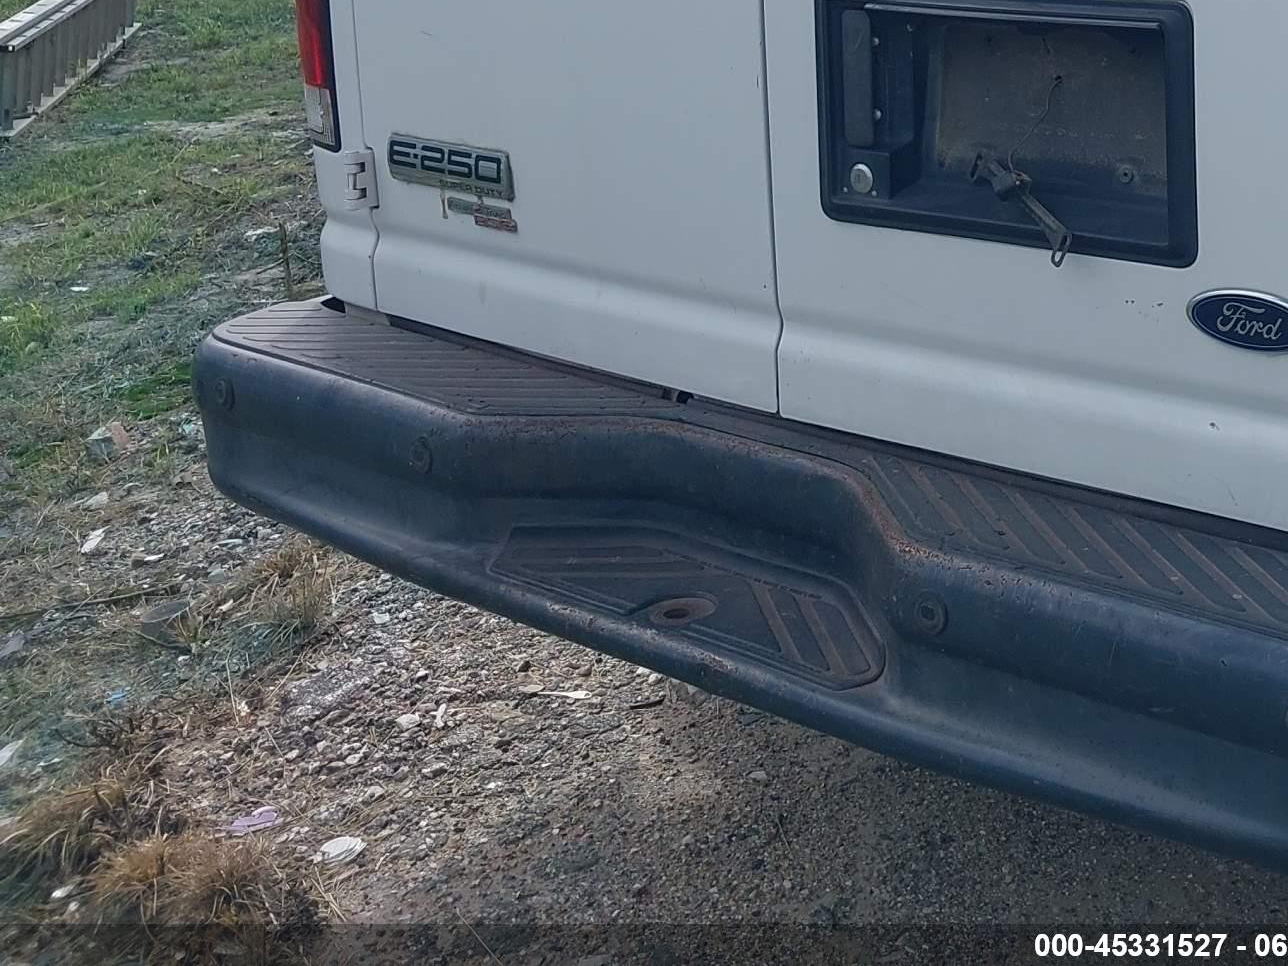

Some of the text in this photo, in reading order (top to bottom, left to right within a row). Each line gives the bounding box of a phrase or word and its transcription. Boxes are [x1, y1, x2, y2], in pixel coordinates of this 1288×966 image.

[389, 140, 502, 184] E-250
[474, 185, 503, 198] DUTY
[1216, 301, 1283, 340] Ford
